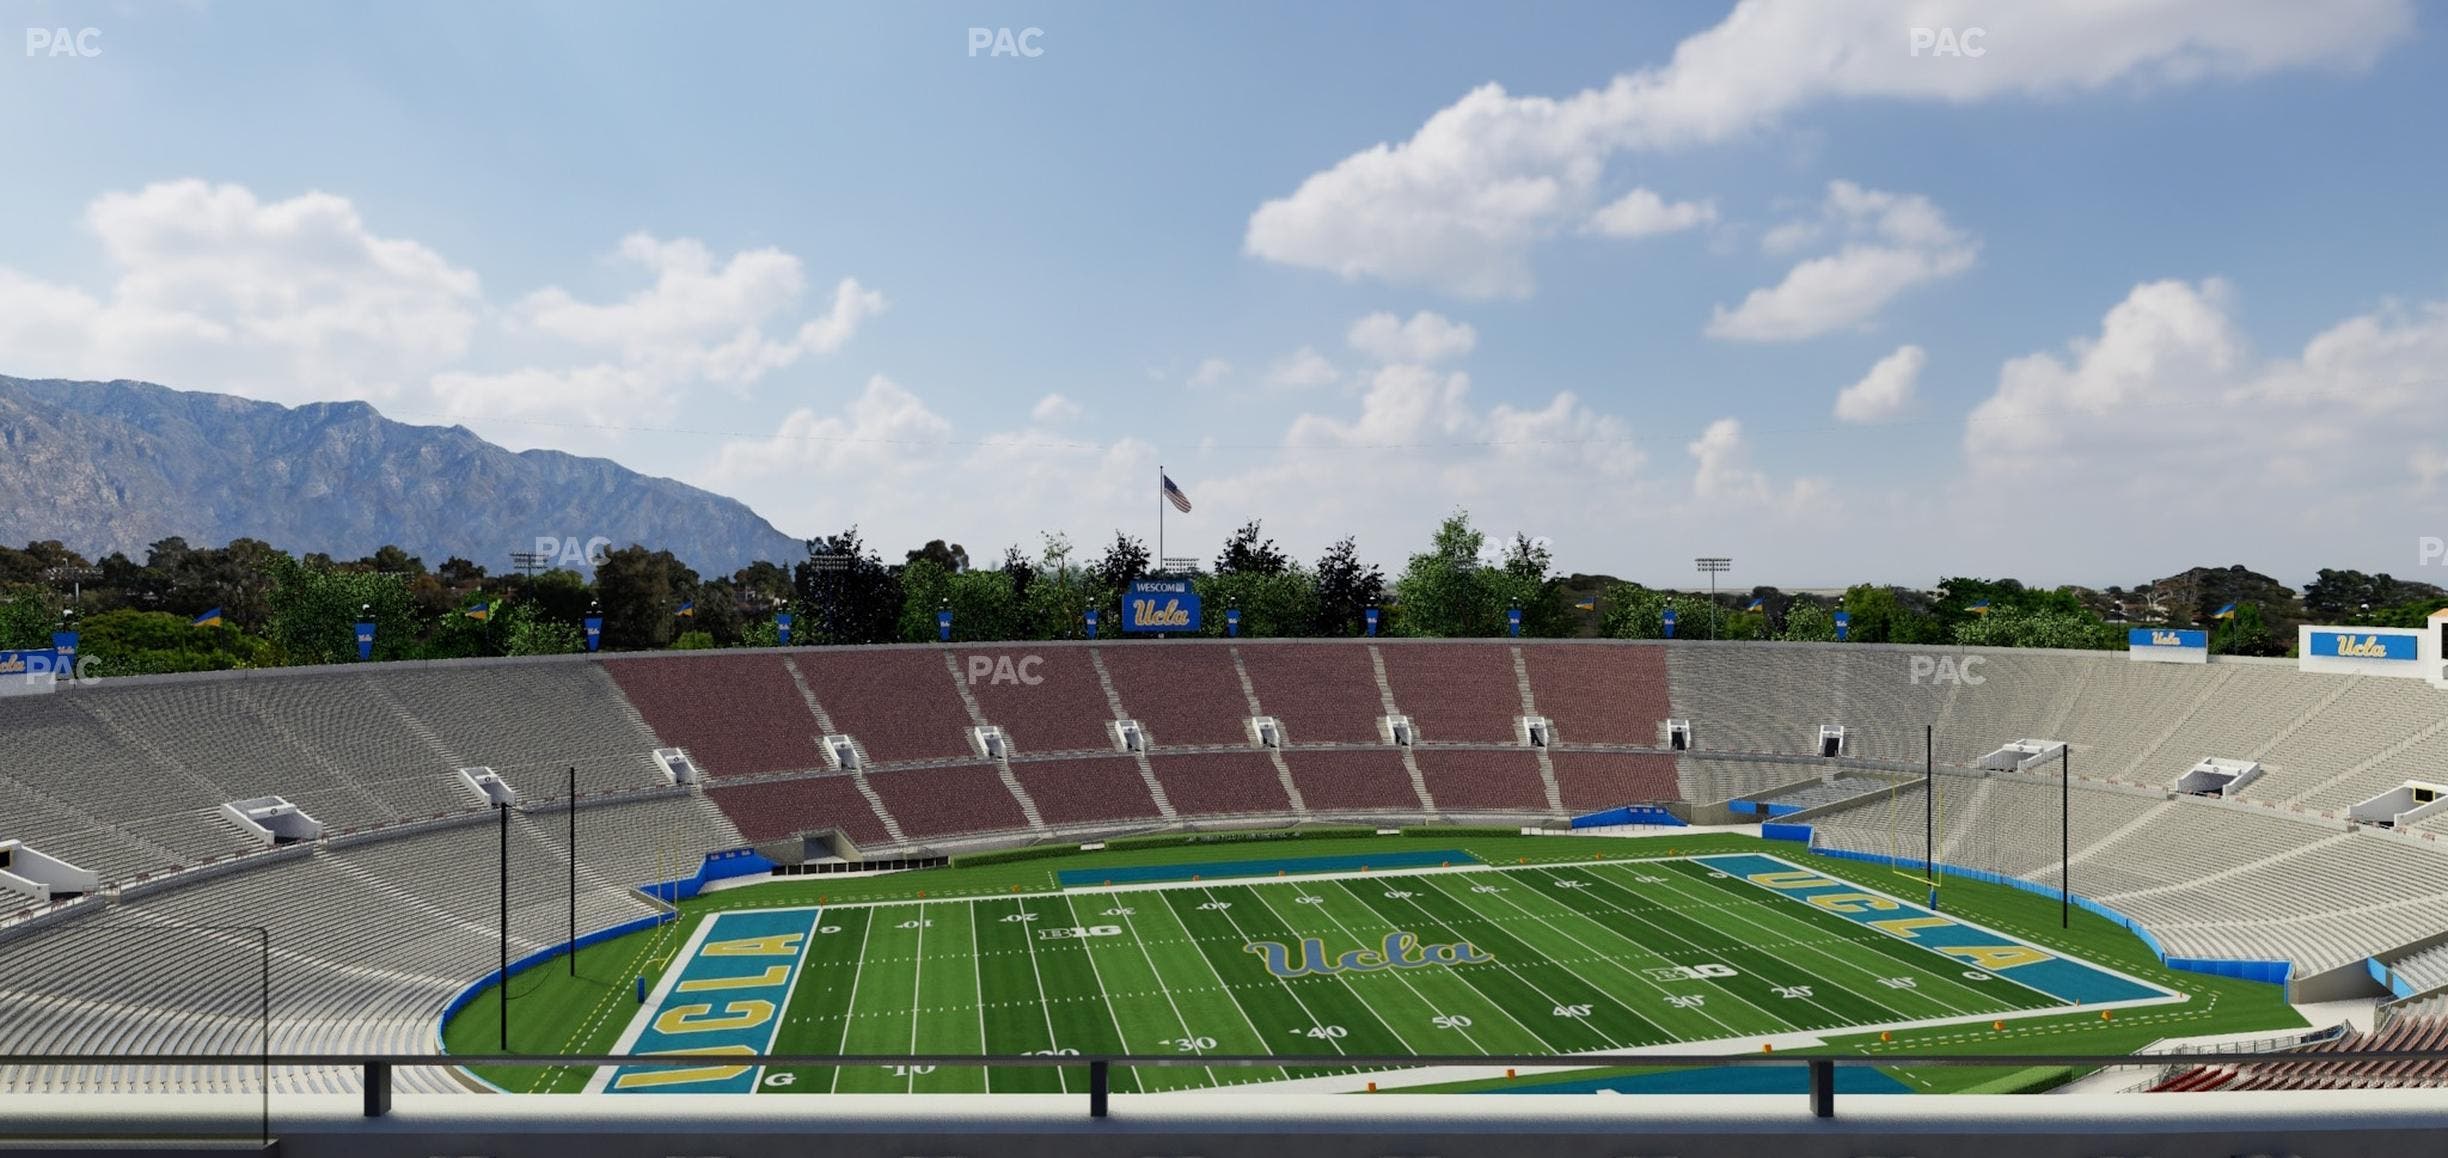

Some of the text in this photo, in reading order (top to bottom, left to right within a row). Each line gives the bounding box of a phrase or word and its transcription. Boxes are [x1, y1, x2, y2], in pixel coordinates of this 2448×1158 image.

[1136, 583, 1175, 592] WESCOM
[1133, 599, 1190, 626] Ucla
[2337, 635, 2387, 658] Ucla
[1747, 871, 2057, 971] UCLA
[1243, 931, 1495, 978] Ucla
[614, 932, 805, 1089] UCLA
[1553, 1005, 1591, 1018] 40
[1432, 1015, 1473, 1028] 50
[1307, 1025, 1348, 1039] 40
[1175, 1036, 1217, 1052] 30
[764, 1072, 797, 1087] G
